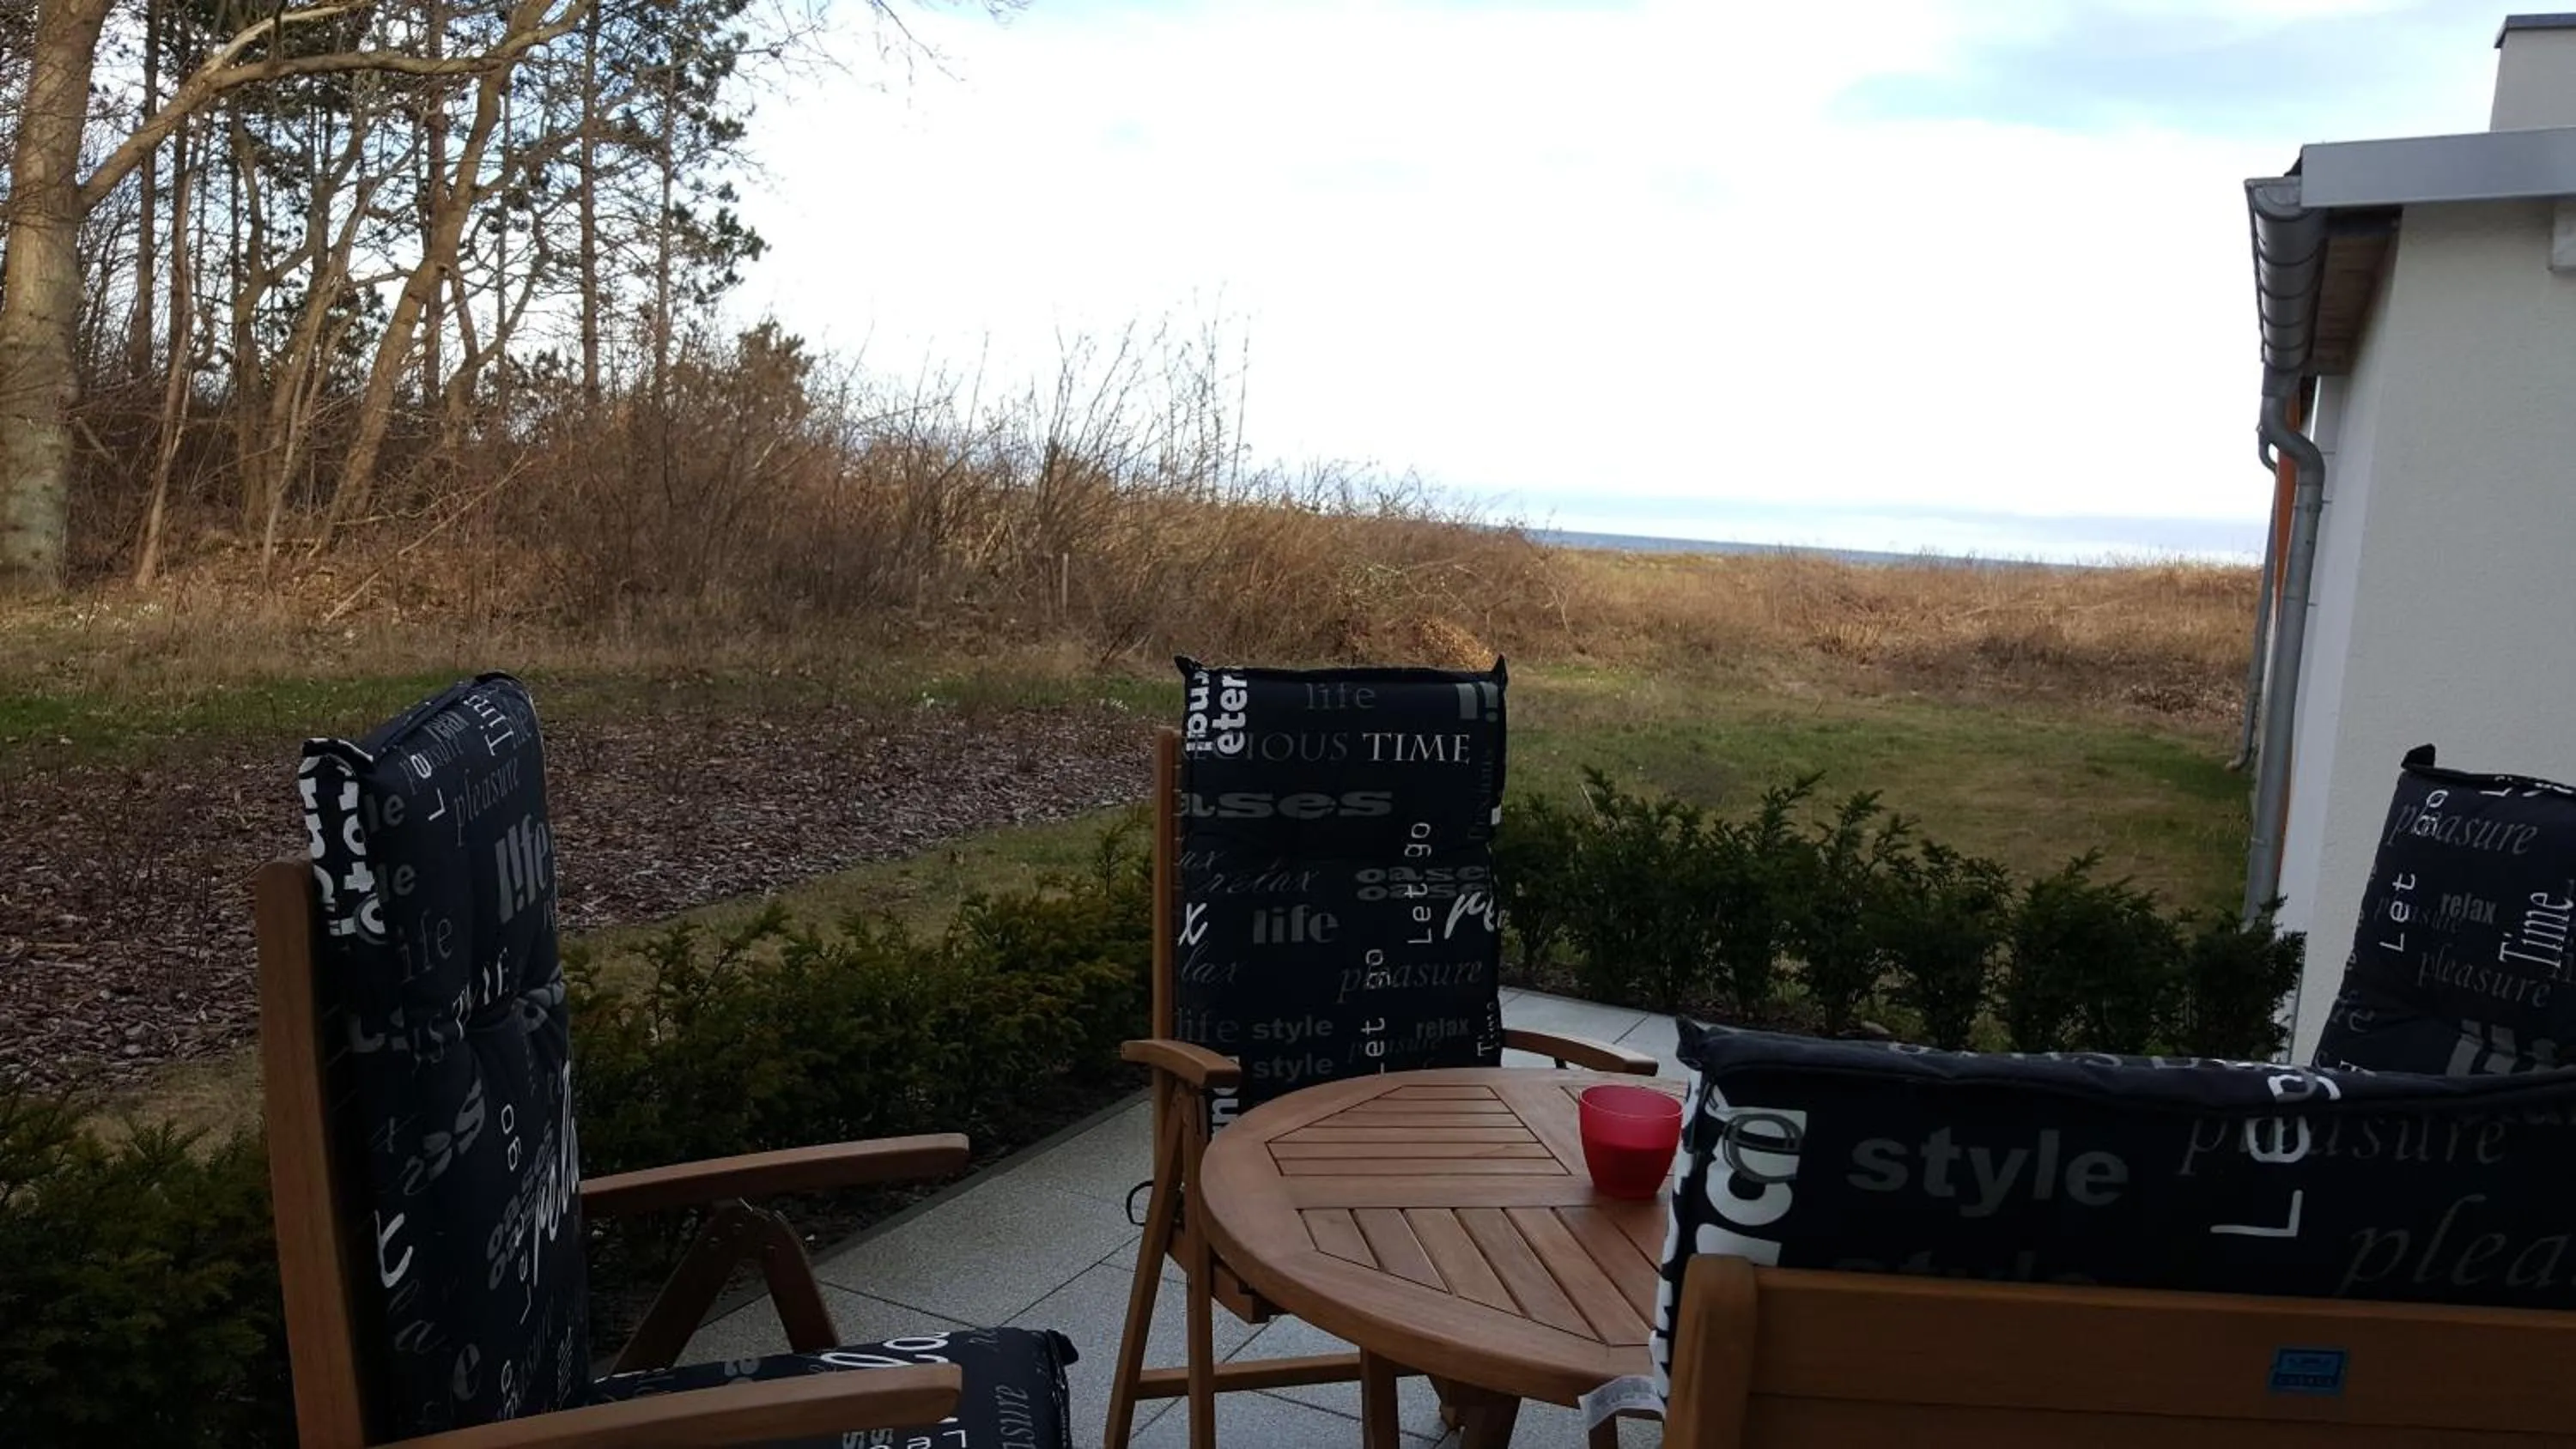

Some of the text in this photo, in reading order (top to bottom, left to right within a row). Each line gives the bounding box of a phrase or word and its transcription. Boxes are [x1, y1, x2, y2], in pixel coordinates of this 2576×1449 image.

[1304, 682, 1378, 712] life
[1362, 731, 1473, 766] TIME
[2385, 803, 2539, 855] pleasure
[494, 813, 549, 925] life
[1354, 865, 1492, 885] oase
[1404, 822, 1434, 944] Let go
[1252, 904, 1341, 945] life
[2378, 870, 2416, 955] Let
[2440, 890, 2499, 924] relax
[2498, 890, 2575, 969] Time
[1336, 960, 1484, 1004] pleasure
[2415, 943, 2554, 1009] pleasure
[1251, 1014, 1334, 1045] style
[1416, 1016, 1470, 1041] relax
[1253, 1052, 1334, 1083] style
[1845, 1125, 2129, 1217] style
[2331, 1192, 2575, 1296] plea
